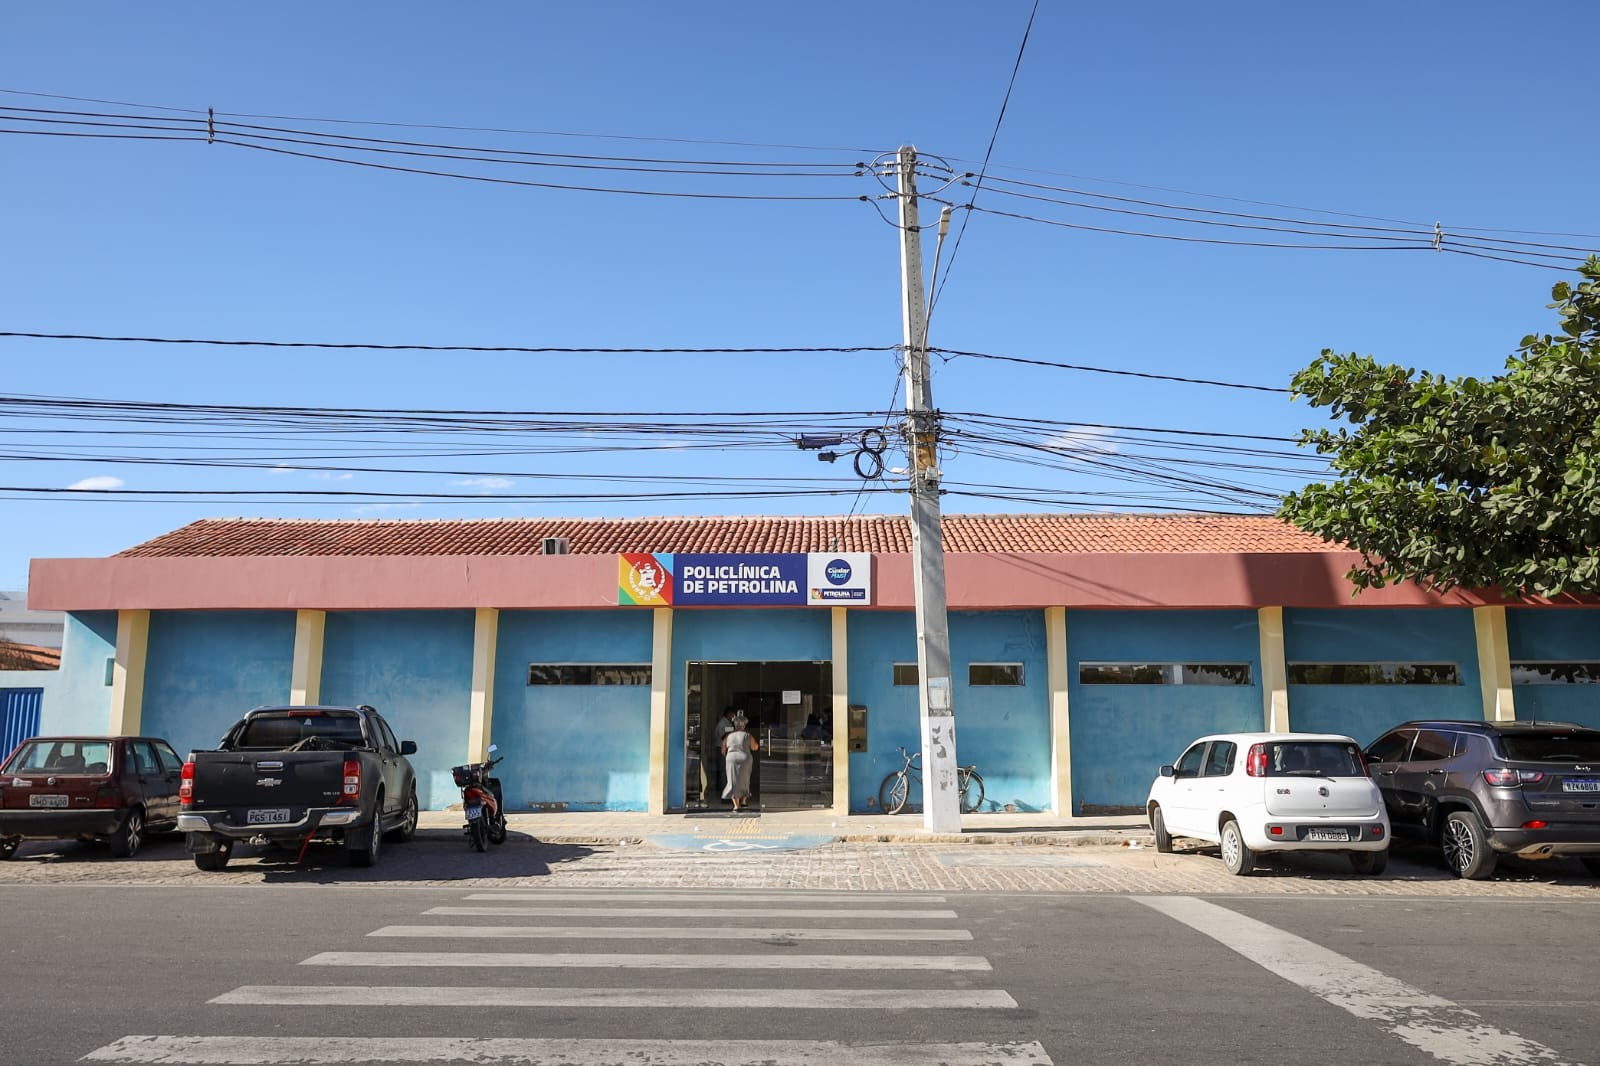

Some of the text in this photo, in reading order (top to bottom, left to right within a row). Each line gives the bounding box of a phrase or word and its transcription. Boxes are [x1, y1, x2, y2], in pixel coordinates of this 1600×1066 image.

[683, 563, 781, 579] POLICLÍNICA
[683, 580, 799, 594] DE PETROLINA
